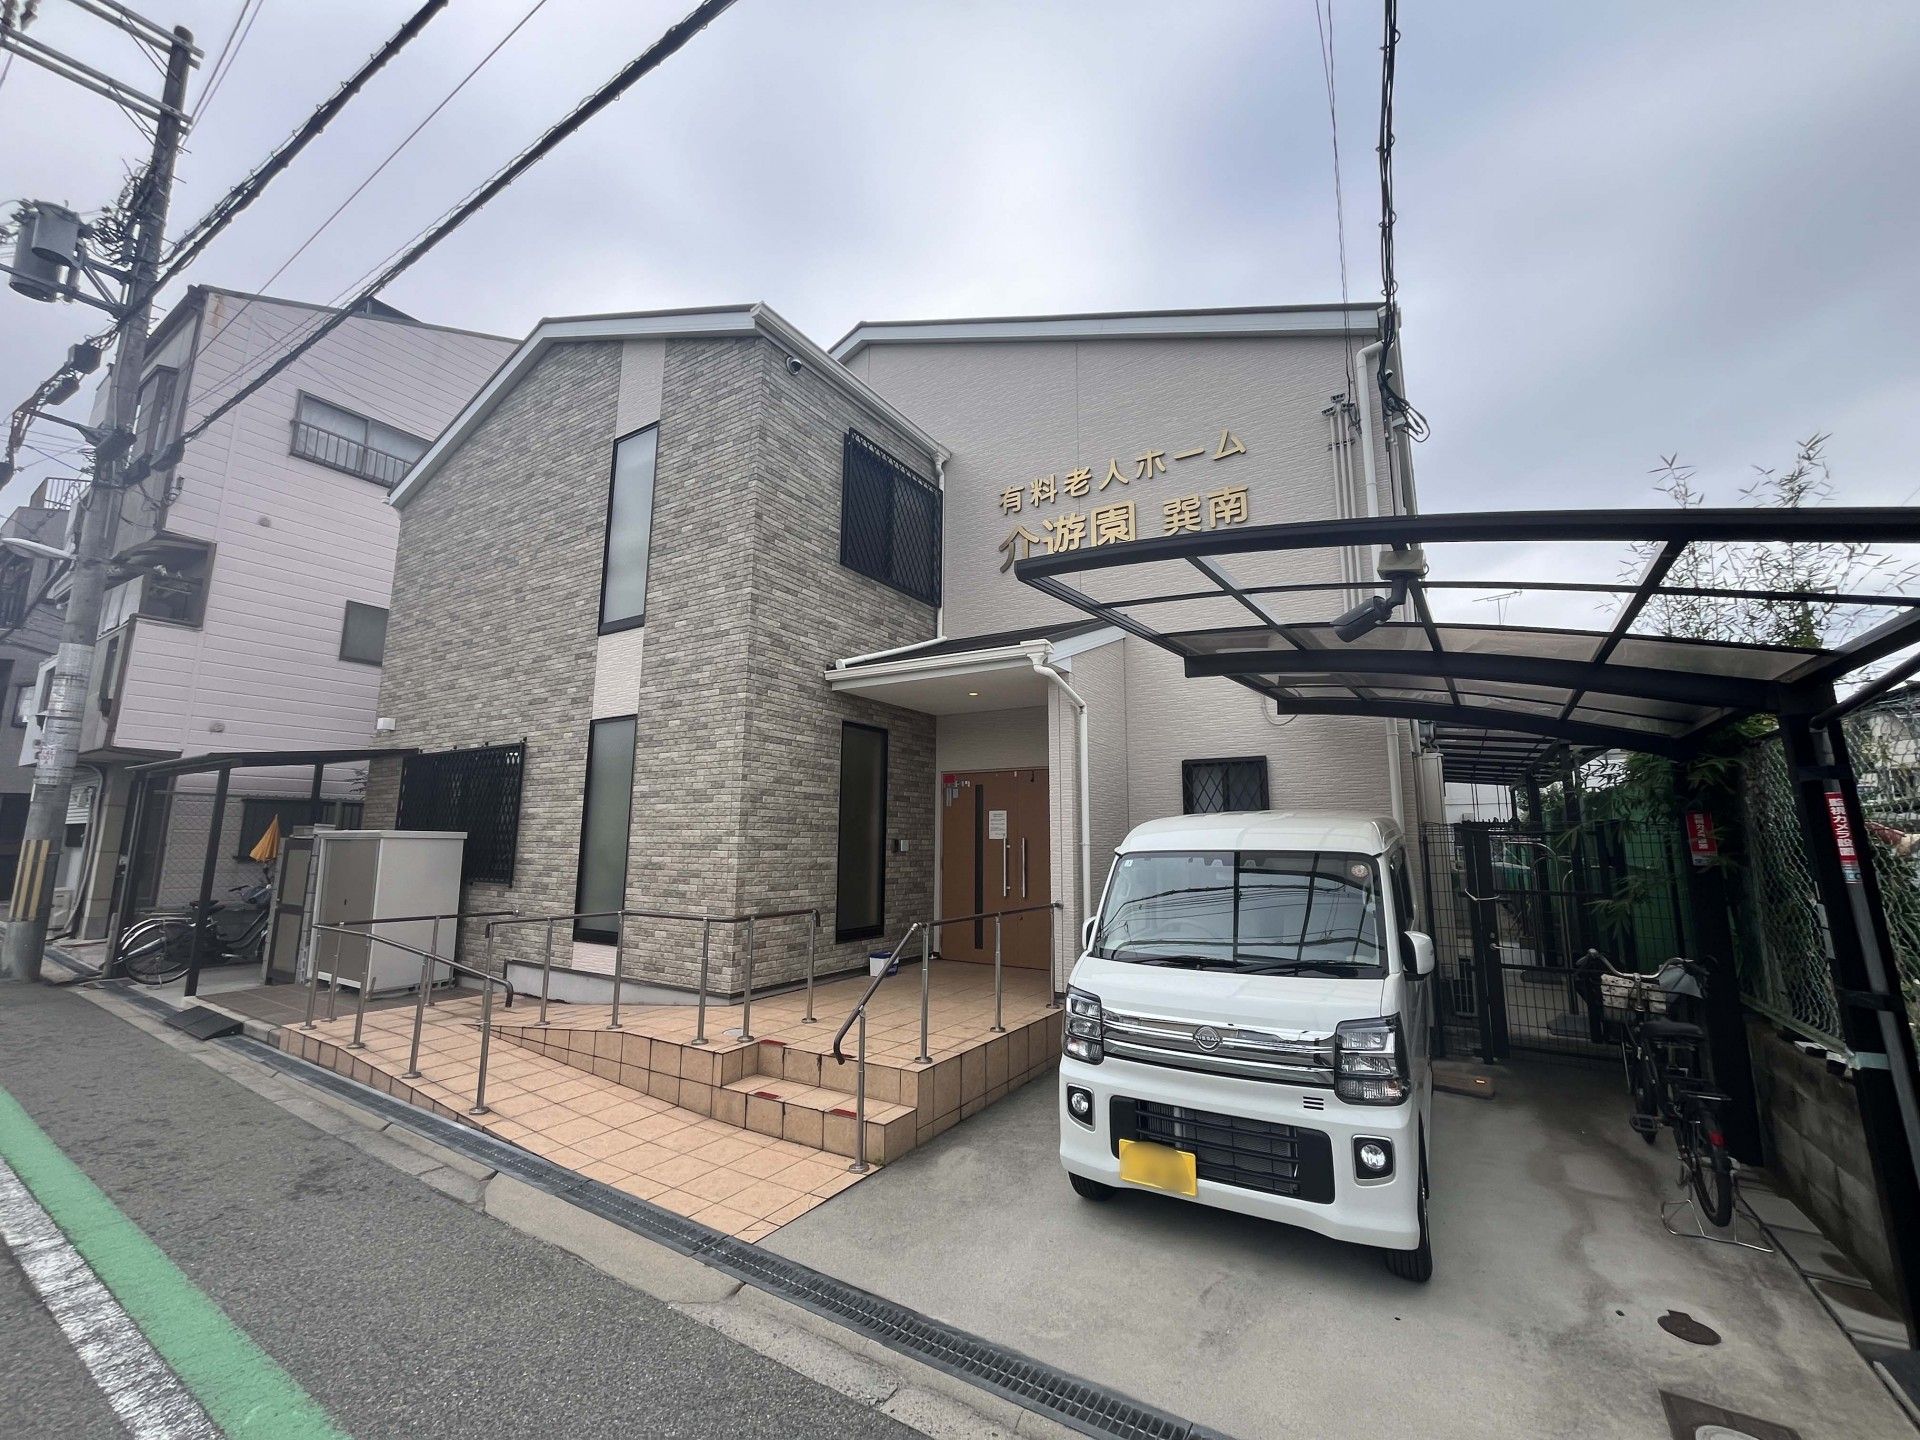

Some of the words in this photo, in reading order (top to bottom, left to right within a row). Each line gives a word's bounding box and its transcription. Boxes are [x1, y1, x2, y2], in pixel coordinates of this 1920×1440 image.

[1000, 428, 1247, 515] 有料老人ホーム
[1163, 486, 1248, 534] 巽南
